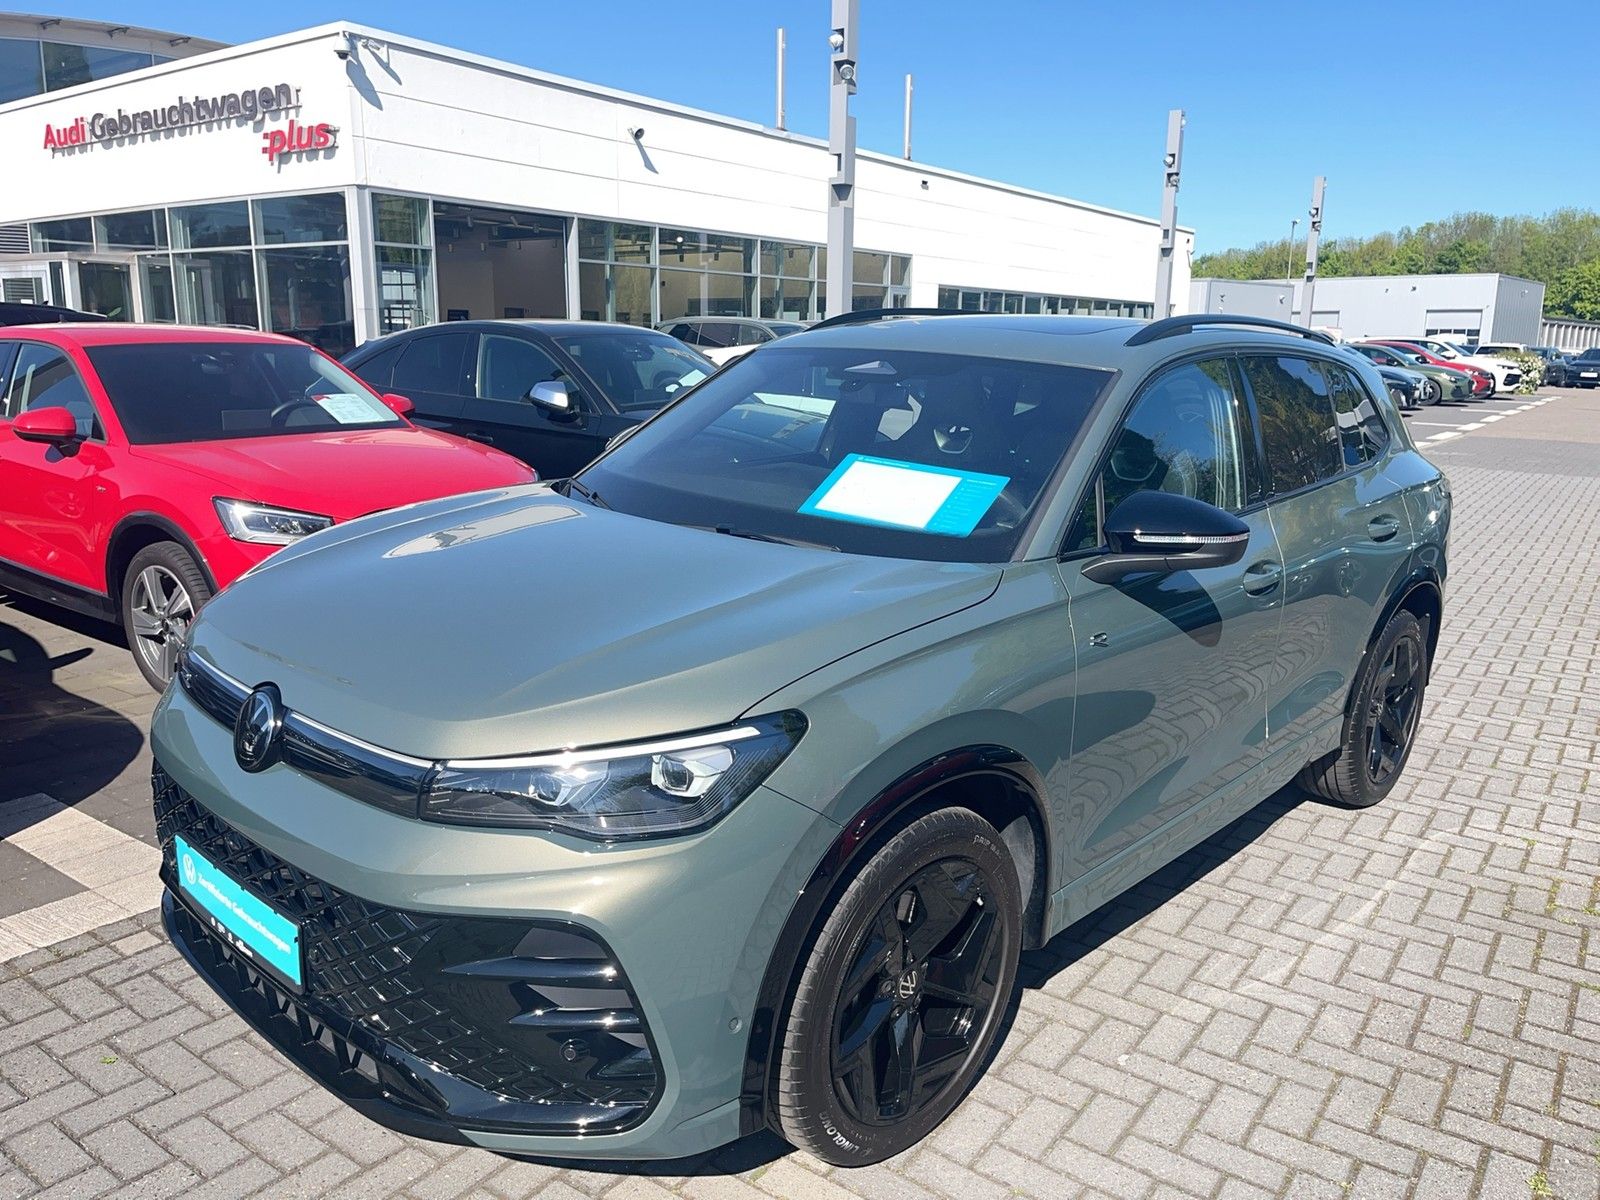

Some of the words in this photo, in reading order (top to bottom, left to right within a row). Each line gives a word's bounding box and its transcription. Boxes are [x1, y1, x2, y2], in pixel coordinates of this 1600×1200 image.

[43, 116, 86, 150] Audi
[91, 82, 292, 140] Gebrauchtwagen
[819, 1111, 860, 1154] LINGLONG
